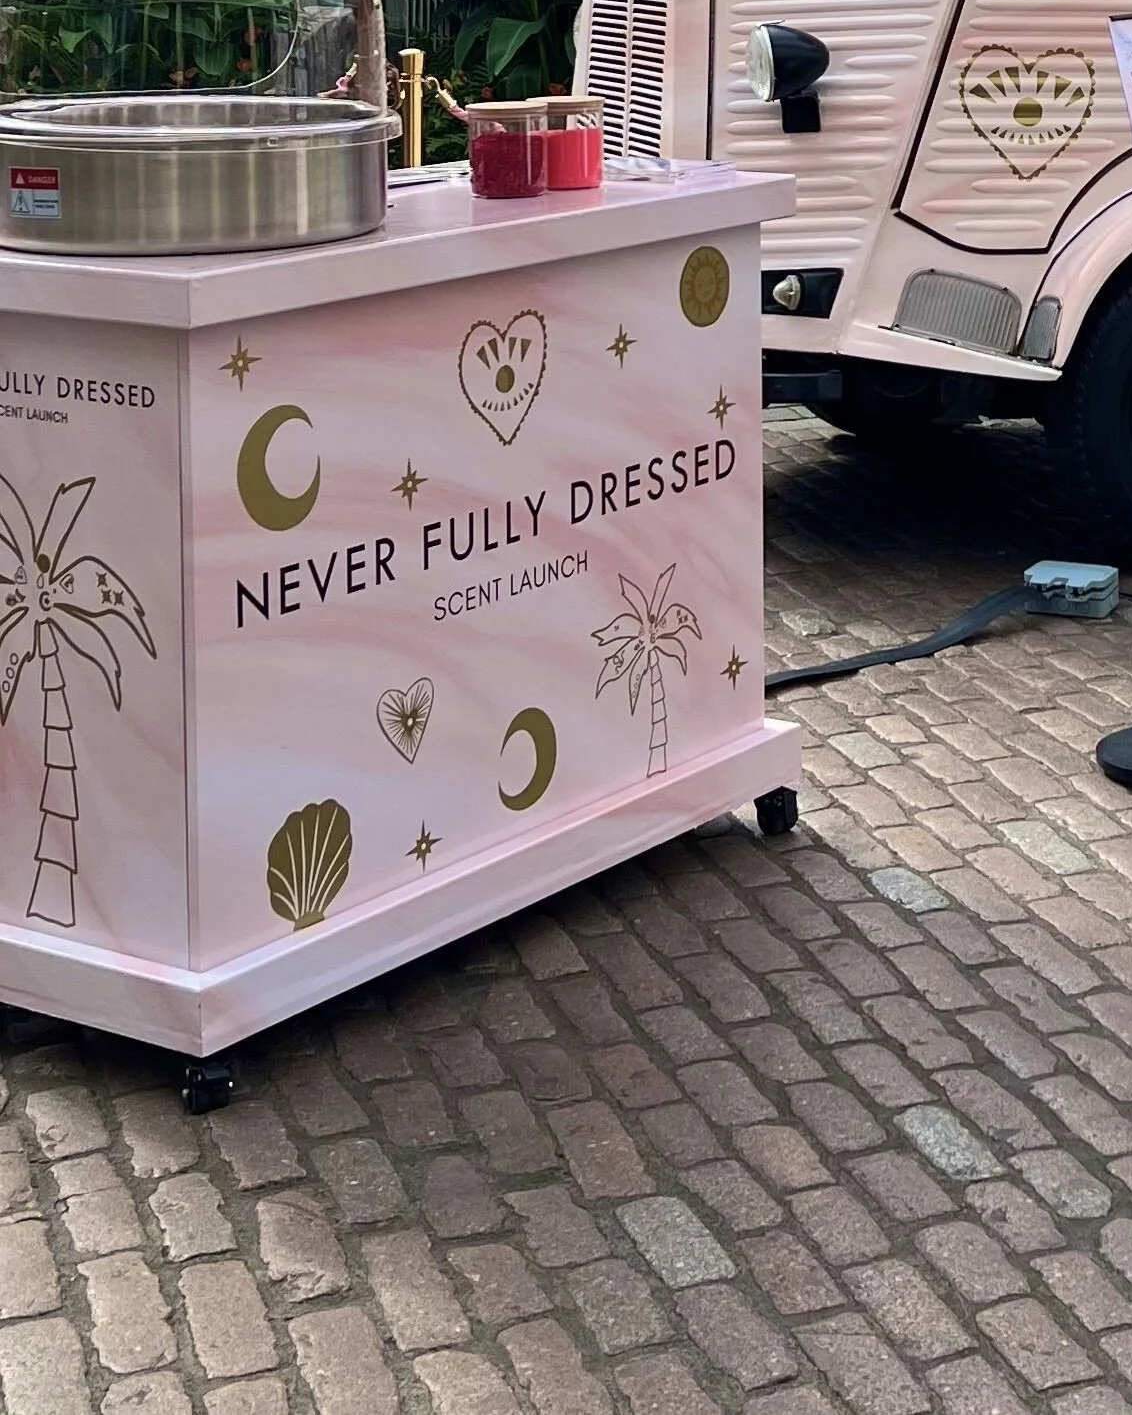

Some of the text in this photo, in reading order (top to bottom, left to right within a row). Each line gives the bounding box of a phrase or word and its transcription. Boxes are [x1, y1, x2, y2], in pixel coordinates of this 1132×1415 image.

[27, 407, 68, 423] LAUNCH
[57, 377, 155, 408] DRESSED
[236, 439, 736, 629] NEVER FULLY DRESSED
[434, 550, 589, 622] SCENT LAUNCH
